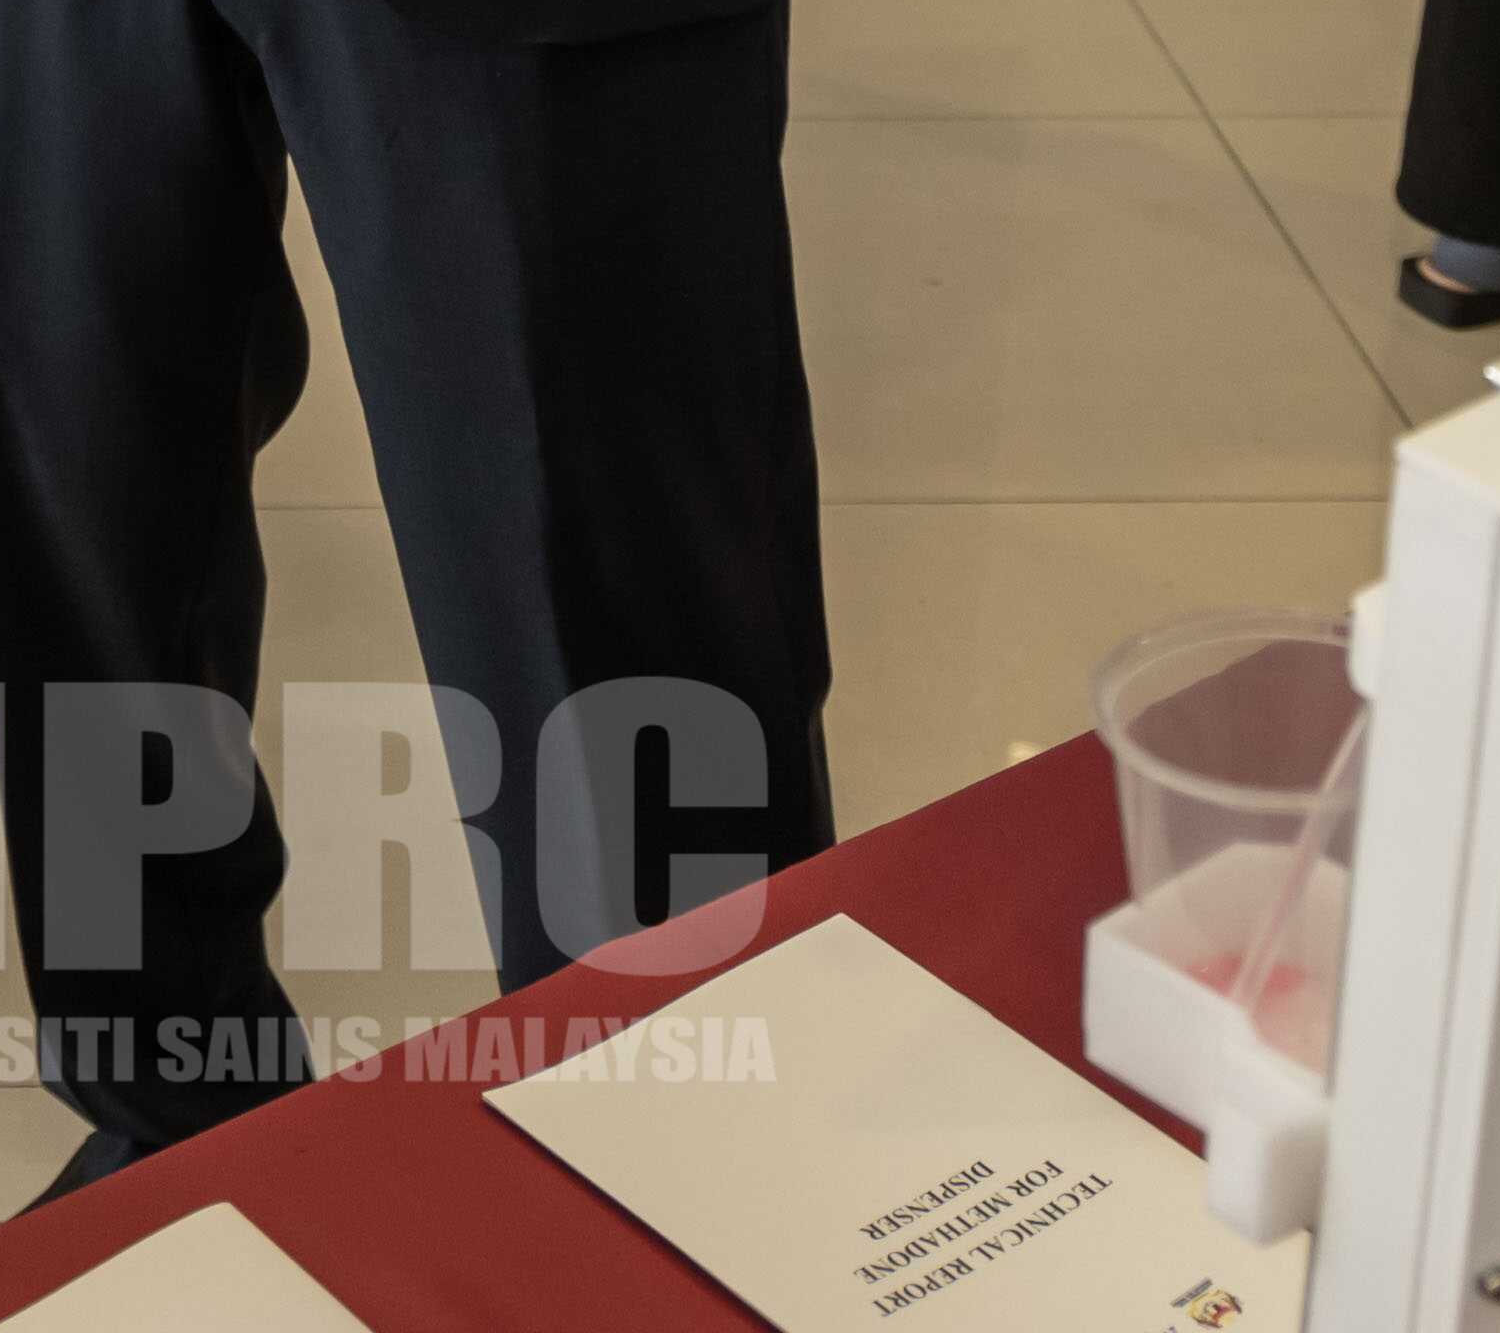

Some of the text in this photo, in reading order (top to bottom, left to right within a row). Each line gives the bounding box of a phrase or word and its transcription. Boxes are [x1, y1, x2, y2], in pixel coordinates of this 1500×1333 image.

[852, 1159, 1065, 1286] FOR METHADONE
[858, 1159, 996, 1243] DISPENSER
[872, 1171, 1114, 1318] TECHNICAL REPORT
